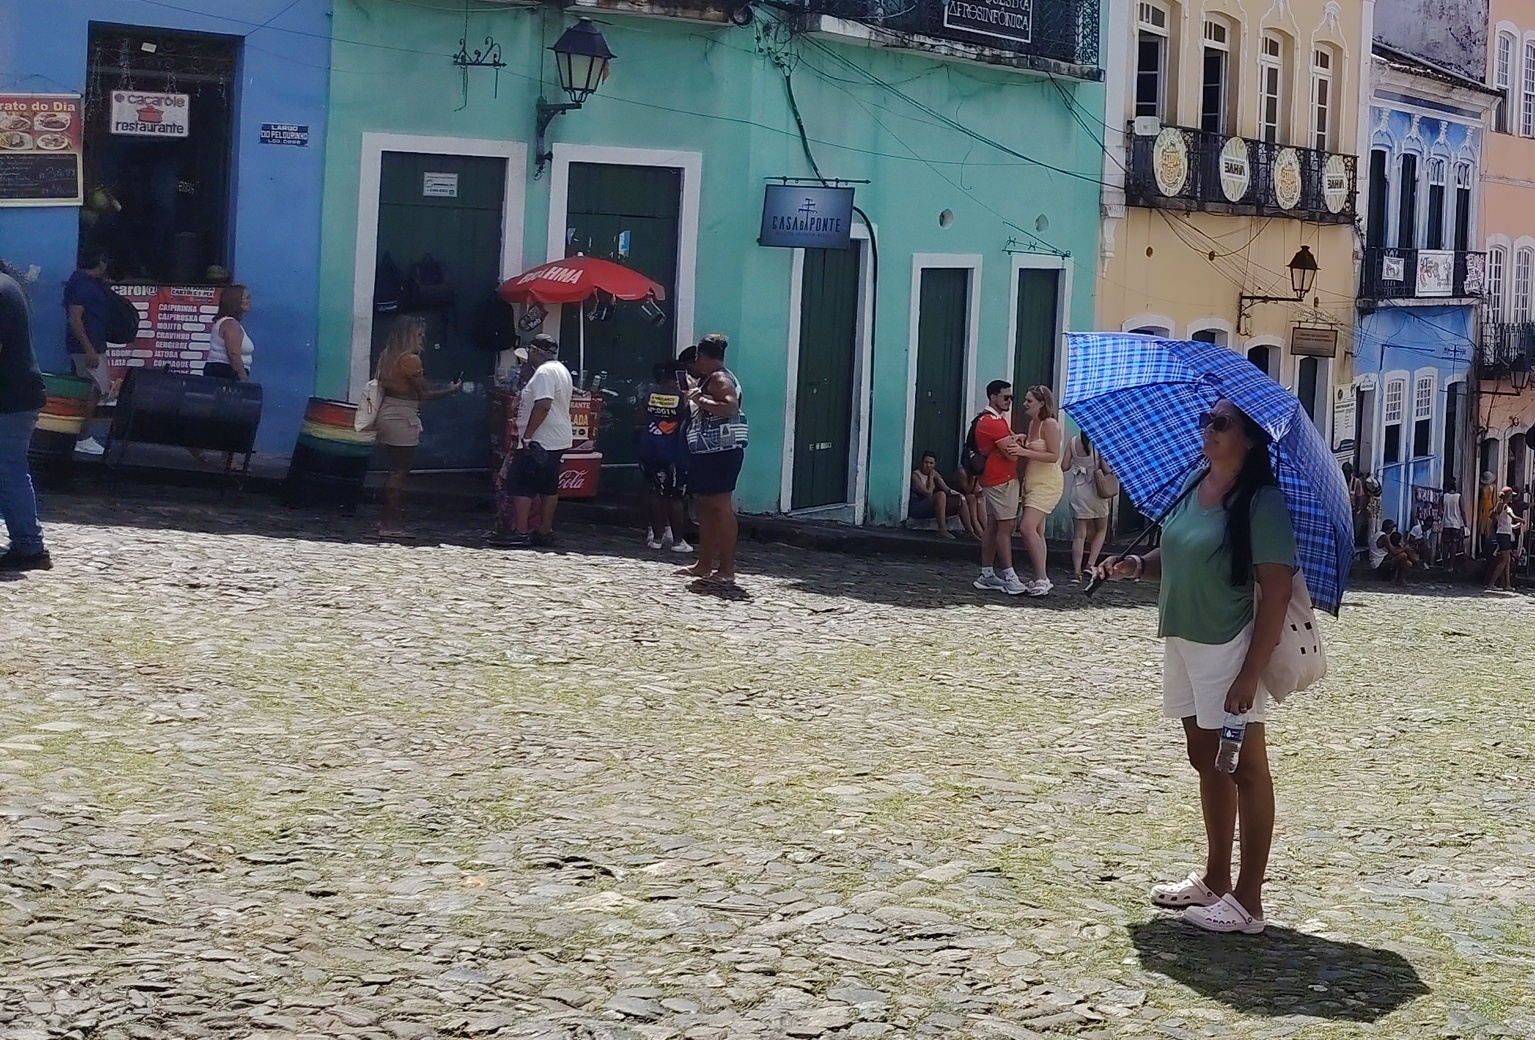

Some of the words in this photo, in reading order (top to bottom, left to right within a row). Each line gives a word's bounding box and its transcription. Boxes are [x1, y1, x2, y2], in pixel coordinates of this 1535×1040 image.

[31, 101, 49, 111] do
[53, 101, 76, 111] Dia
[115, 120, 184, 133] restaurante
[260, 130, 270, 138] DO
[772, 216, 798, 230] CASA
[800, 219, 808, 231] DA
[810, 216, 842, 232] PONTE
[158, 304, 198, 312] CAIPIRINHA
[157, 313, 198, 322] CAIPIROSKA
[156, 322, 182, 331] MOJITO
[155, 332, 190, 340] CRAVINHO
[155, 340, 188, 349] GENGIBRE
